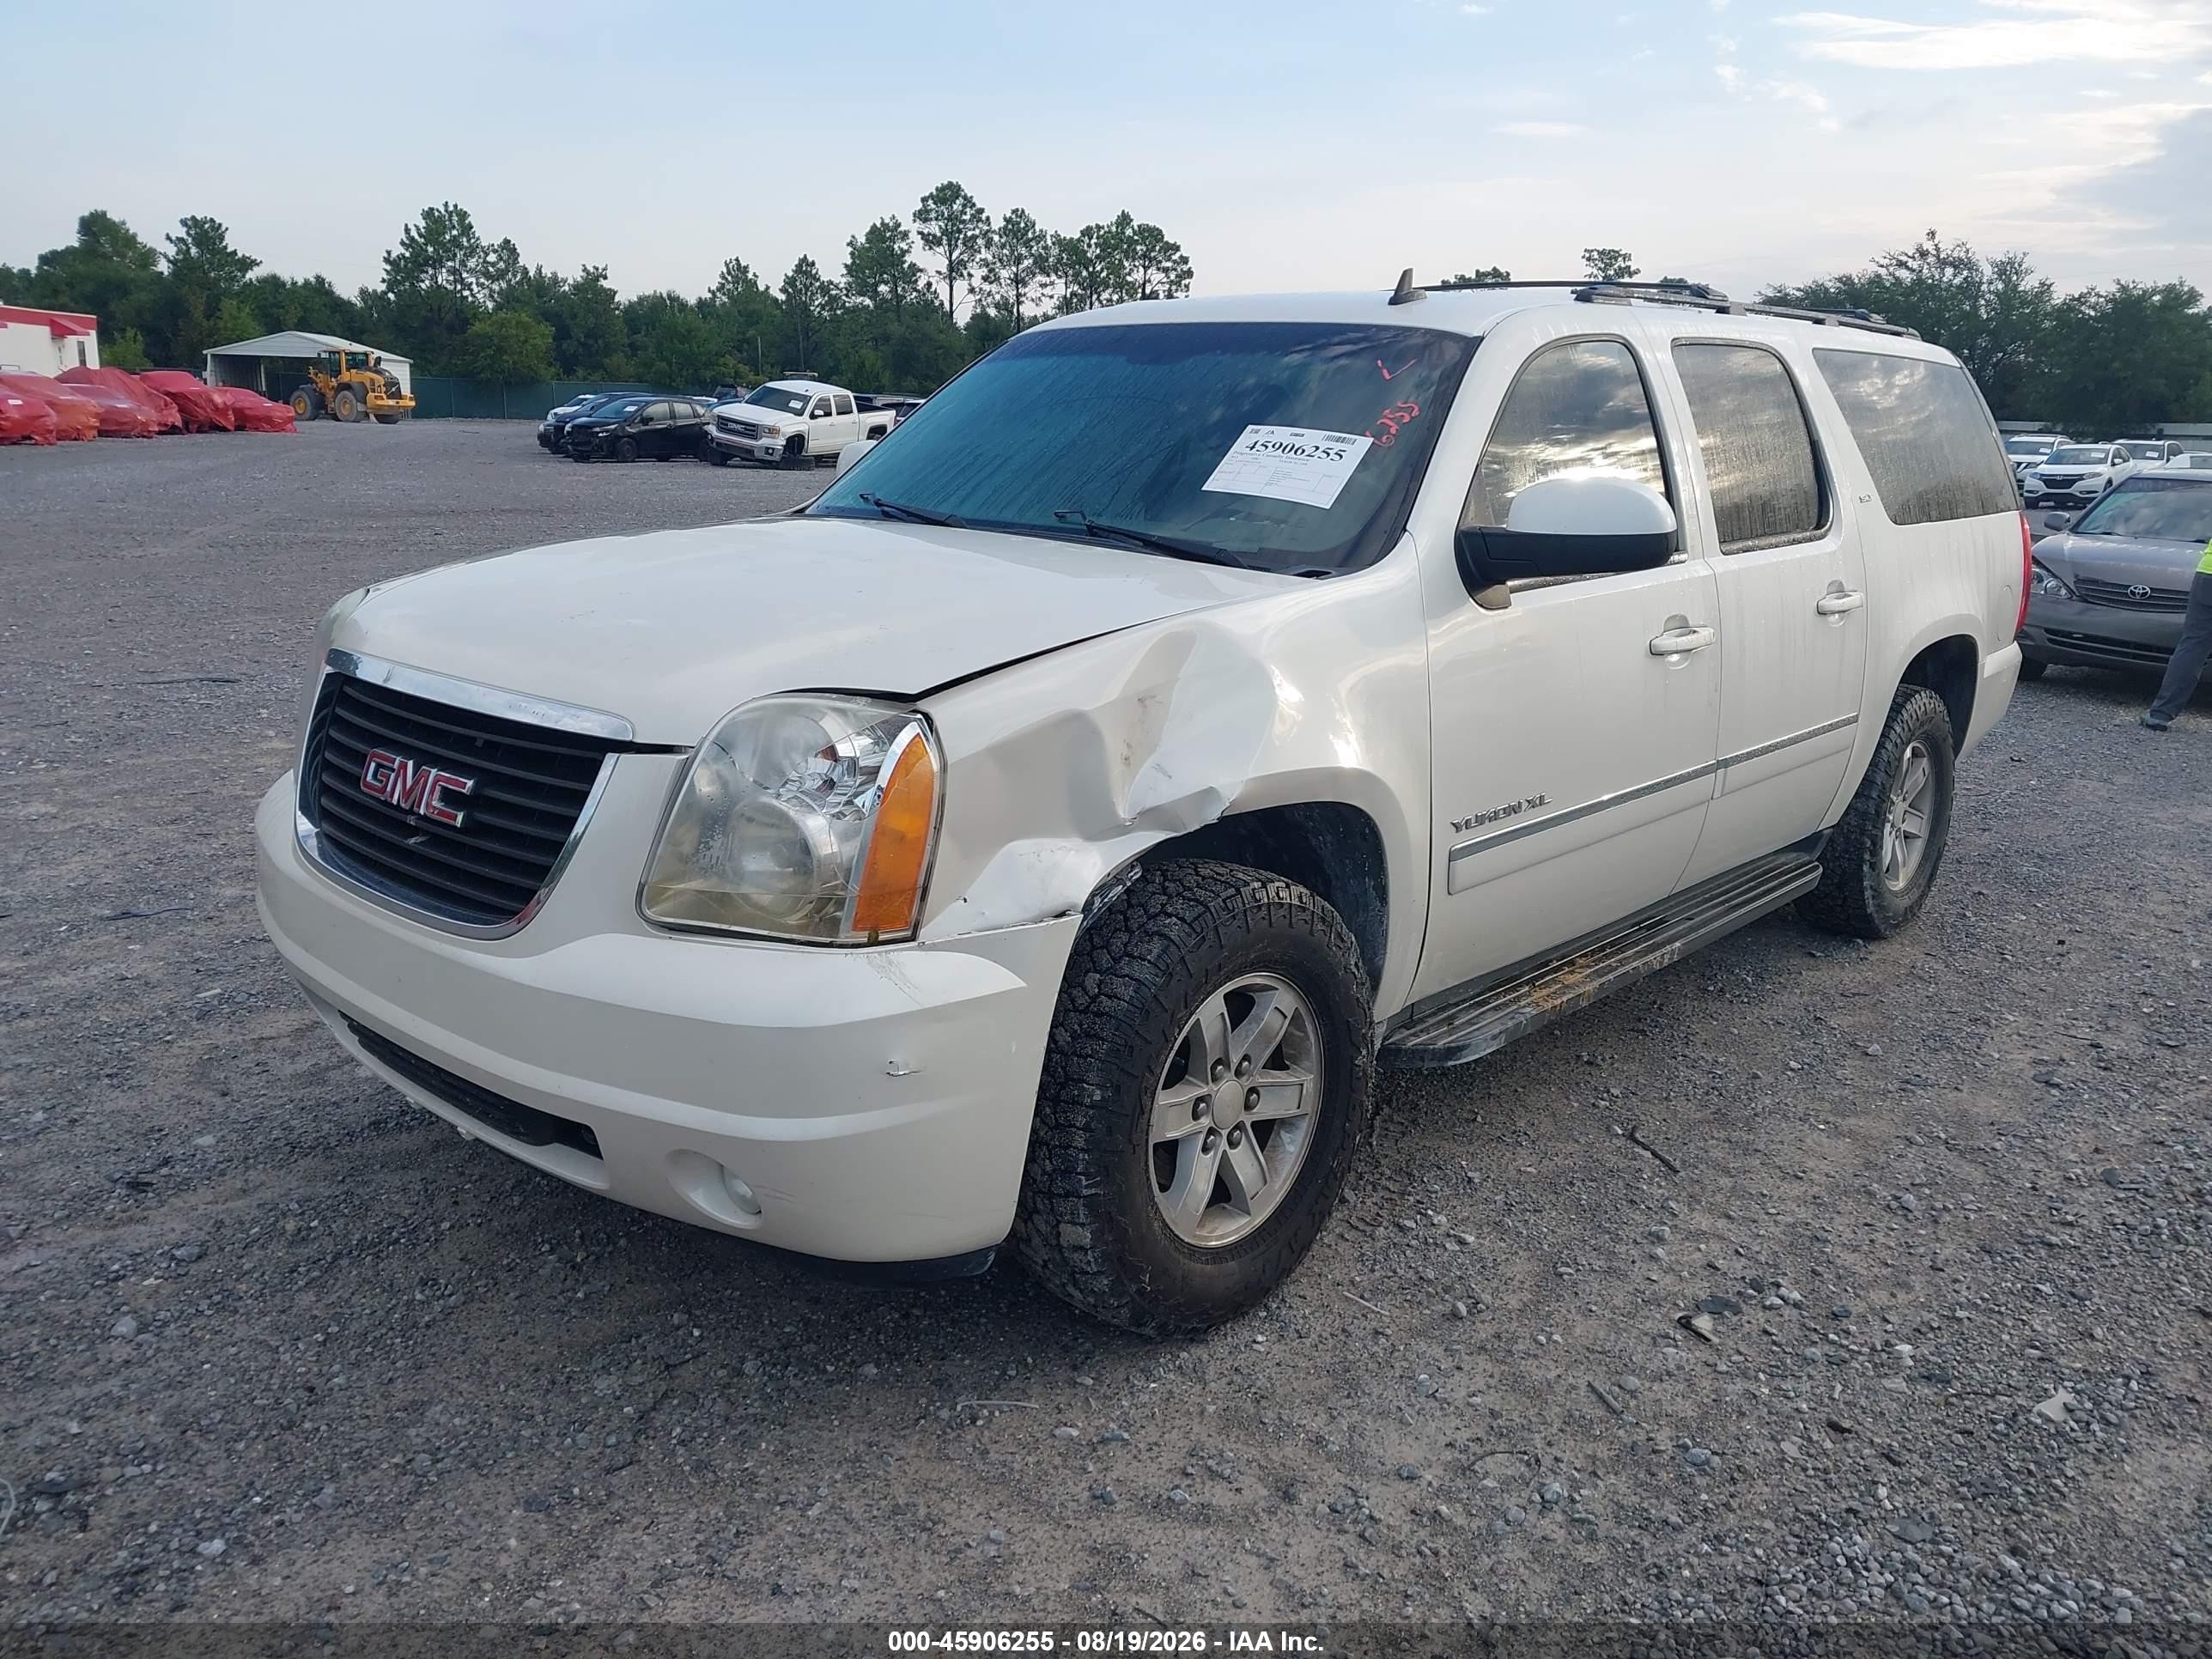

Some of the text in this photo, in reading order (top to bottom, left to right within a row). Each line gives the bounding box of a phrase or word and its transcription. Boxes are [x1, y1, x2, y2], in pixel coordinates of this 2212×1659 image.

[1245, 439, 1347, 462] 45906255
[361, 748, 474, 828] GMC
[1449, 792, 1553, 833] YUKON XL
